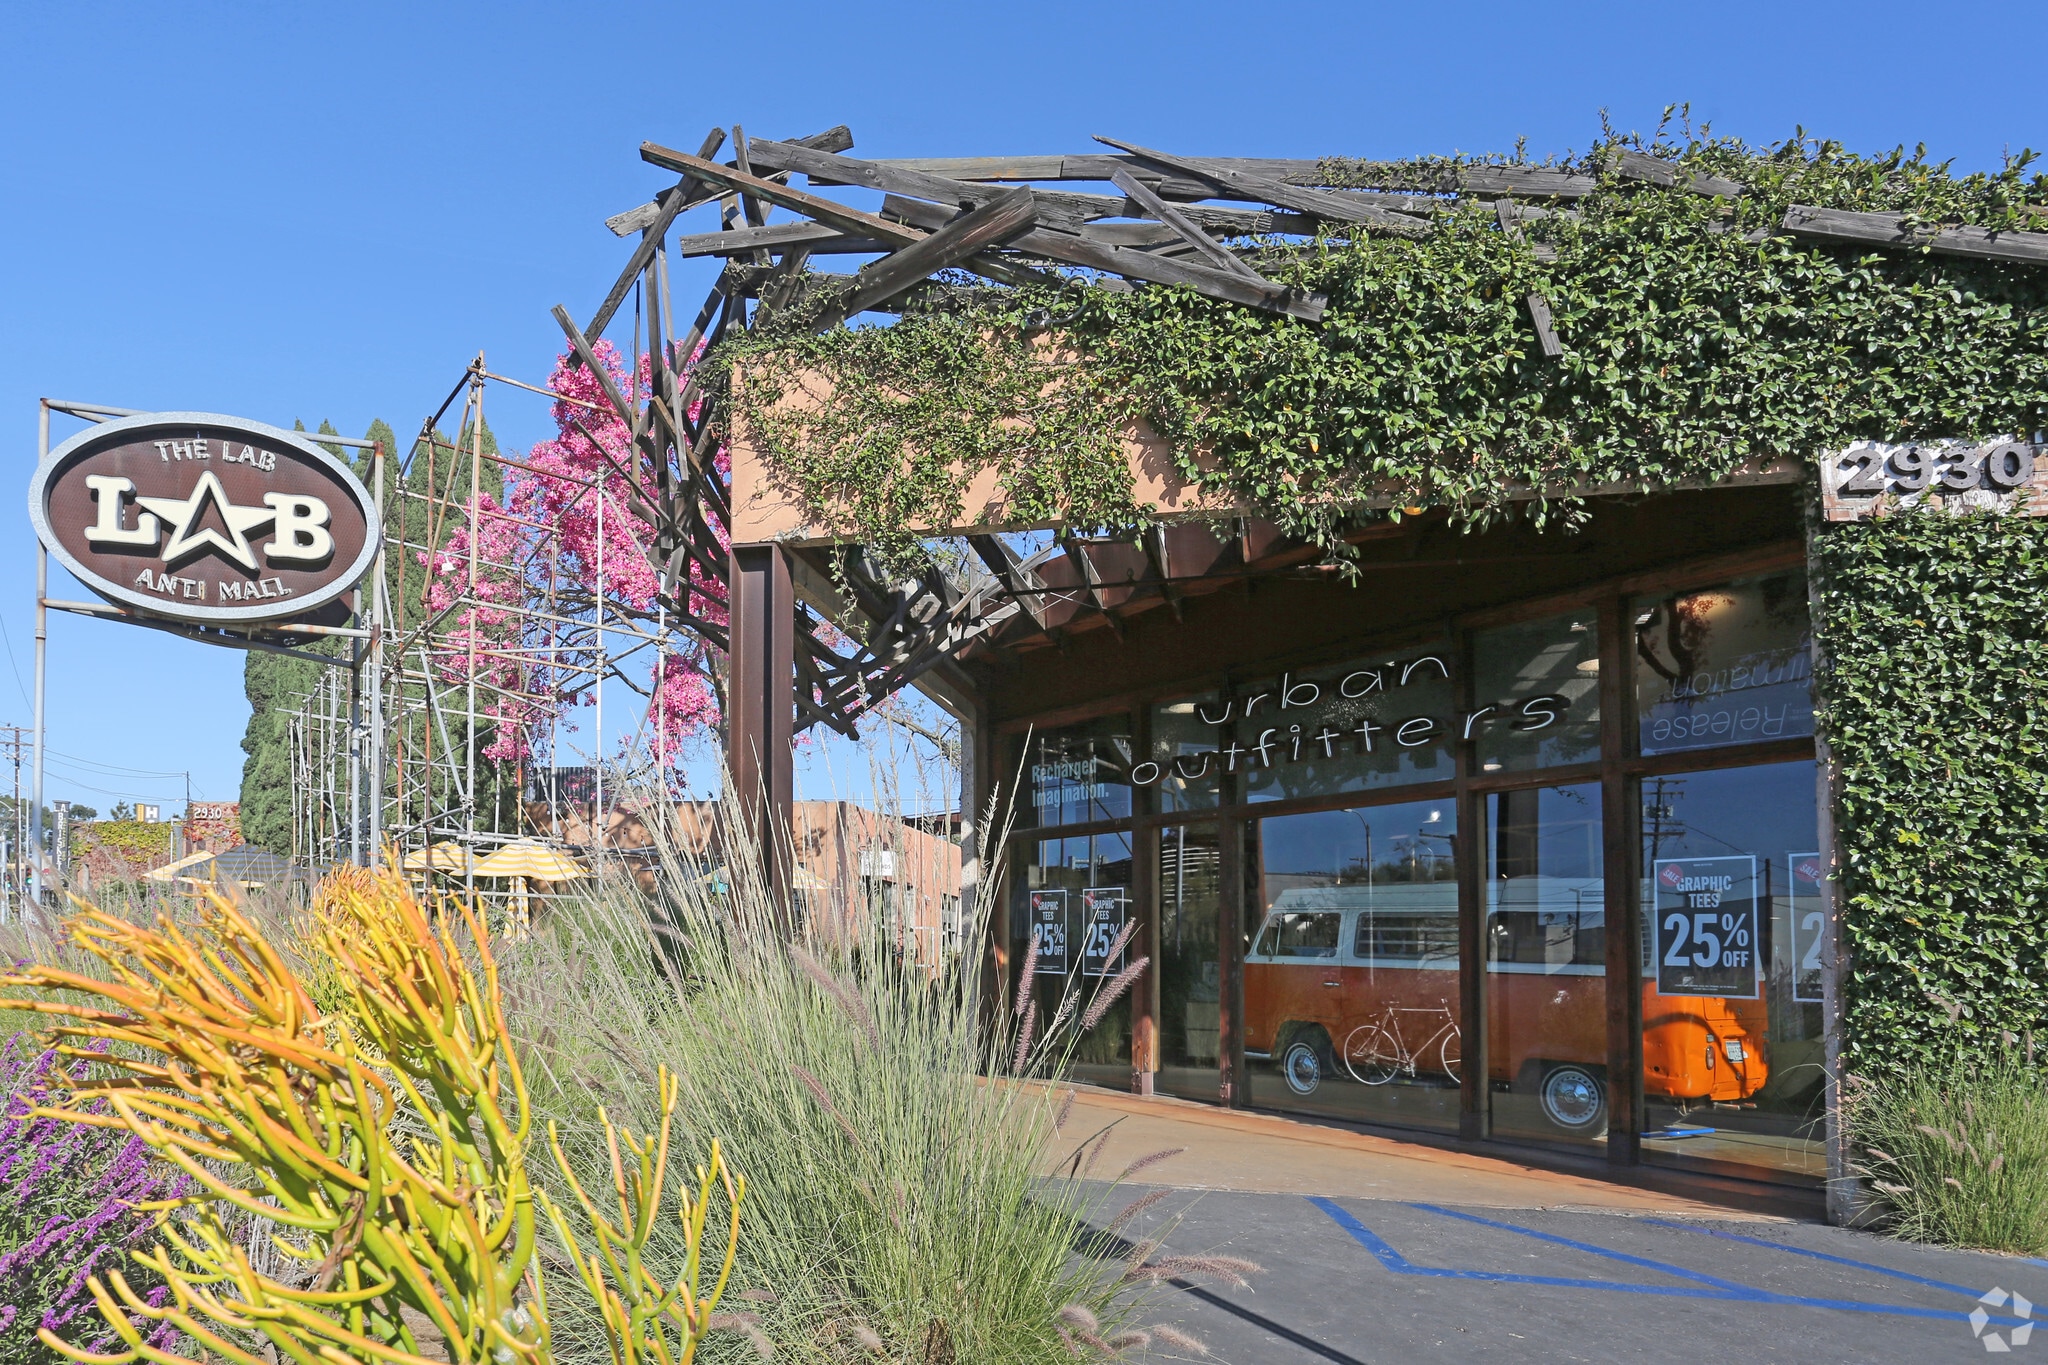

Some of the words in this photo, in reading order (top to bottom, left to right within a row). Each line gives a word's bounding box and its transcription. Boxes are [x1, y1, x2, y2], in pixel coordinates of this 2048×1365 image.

[154, 439, 211, 462] THE
[222, 440, 277, 472] LAB
[1837, 442, 2034, 495] 2930
[134, 568, 206, 600] ANTI
[219, 576, 293, 602] MALL
[1199, 656, 1449, 725] urban
[1652, 703, 1787, 741] Release
[1132, 697, 1556, 785] outfitters
[1031, 756, 1097, 784] Recharged
[1031, 781, 1110, 808] Imagination.
[194, 807, 222, 820] 2930
[1662, 868, 1681, 883] SALE
[1676, 875, 1732, 892] GRAPHIC
[1799, 862, 1819, 880] SALE
[1688, 892, 1720, 908] TEES
[1042, 911, 1054, 921] TEES
[1033, 922, 1064, 956] 25%
[1053, 945, 1064, 956] OFF
[1664, 912, 1749, 968] 25%
[1722, 950, 1749, 968] OFF
